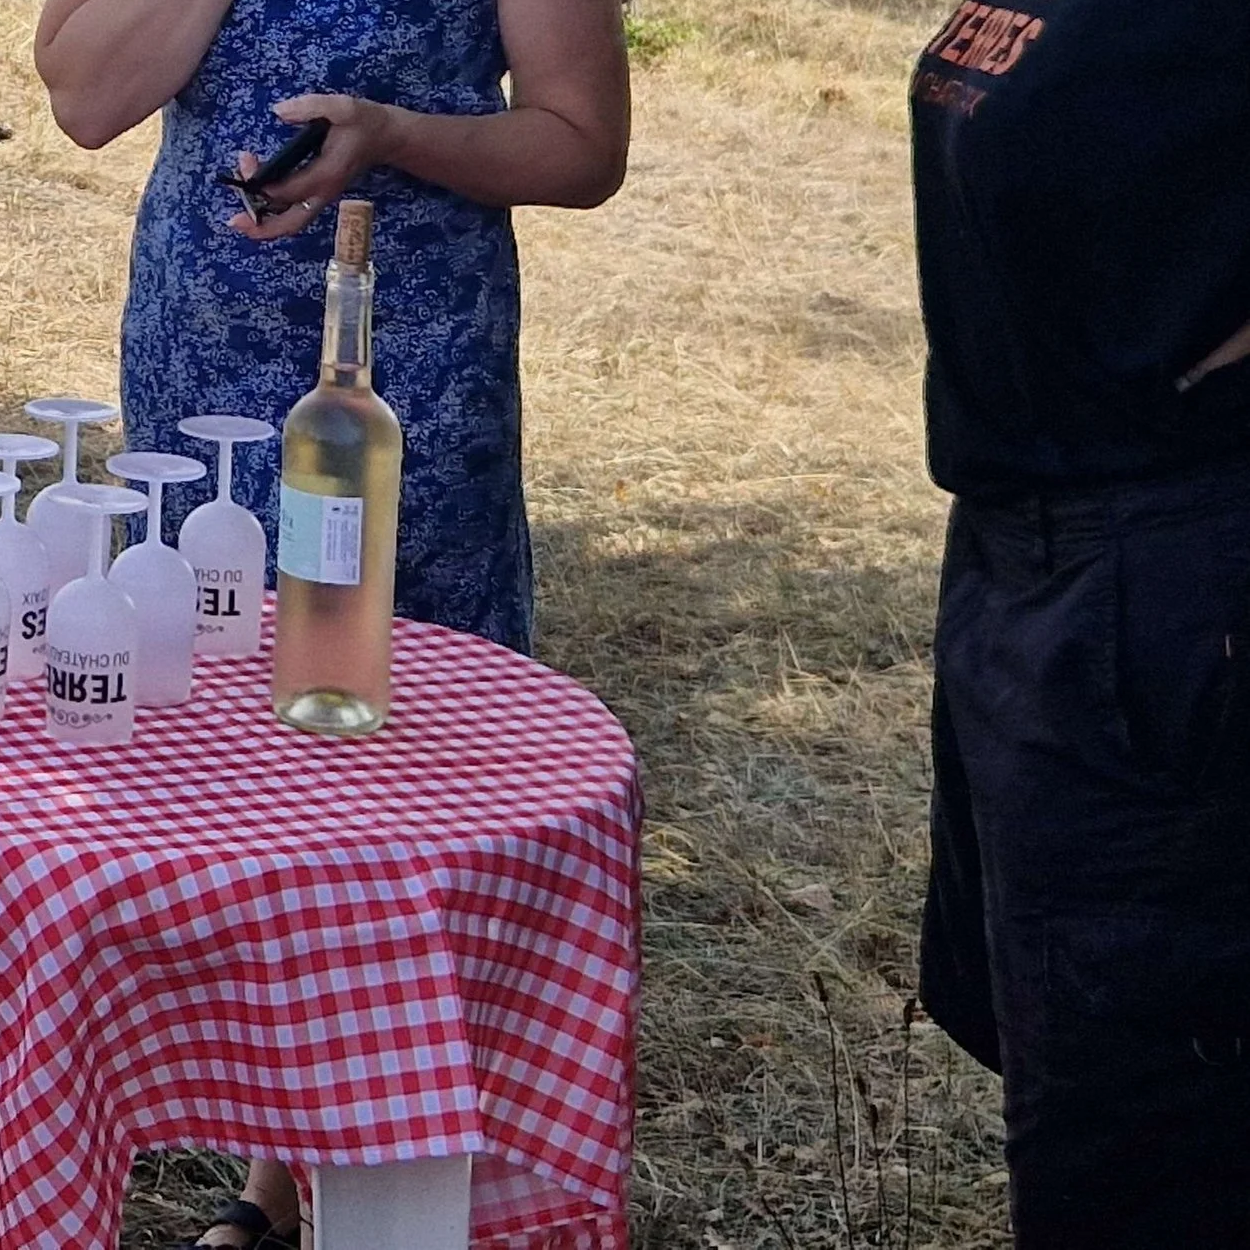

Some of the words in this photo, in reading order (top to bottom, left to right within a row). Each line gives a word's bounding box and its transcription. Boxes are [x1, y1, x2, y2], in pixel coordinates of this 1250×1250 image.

[224, 569, 243, 583] DU
[196, 585, 241, 617] TE
[113, 650, 130, 667] DU
